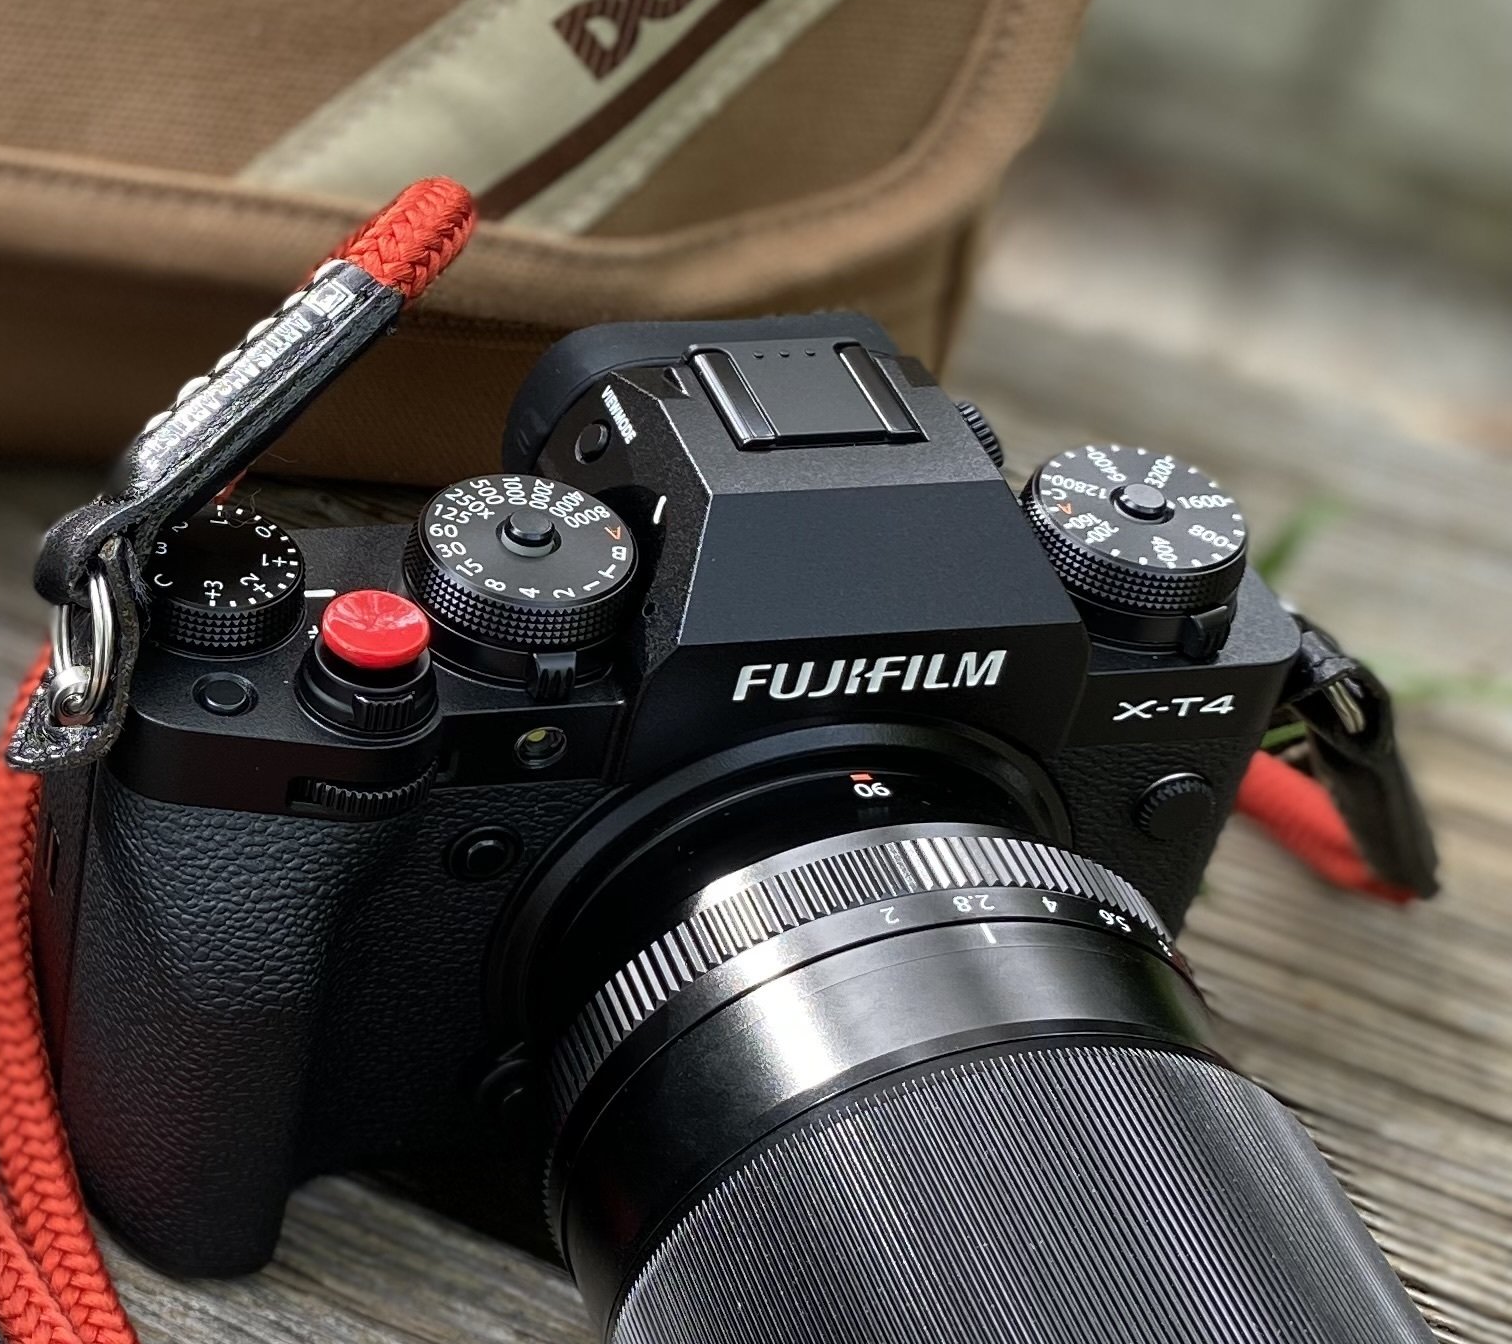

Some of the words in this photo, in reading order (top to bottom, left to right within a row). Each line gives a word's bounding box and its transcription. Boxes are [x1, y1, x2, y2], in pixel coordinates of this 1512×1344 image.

[1087, 451, 1127, 482] 6400
[1144, 458, 1176, 489] 3200
[469, 478, 505, 505] 500
[502, 476, 527, 506] 1000
[529, 478, 555, 510] 2000
[1051, 474, 1107, 499] 12800
[434, 504, 472, 524] 125
[548, 490, 585, 518] 4000
[1177, 494, 1226, 510] 1600
[564, 505, 611, 529] 8000
[429, 524, 458, 537] 60
[604, 525, 621, 540] A
[1088, 520, 1120, 544] 200
[1187, 524, 1229, 548] 800
[436, 541, 467, 558] 30
[611, 545, 627, 561] B
[1150, 536, 1178, 562] 400
[455, 557, 484, 577] 15
[598, 563, 617, 579] T
[484, 578, 506, 591] 8
[518, 586, 540, 599] 4
[552, 586, 577, 599] 2
[732, 649, 1007, 701] FUJIFILM
[1112, 694, 1235, 721] X-T4
[880, 906, 900, 924] 2
[953, 894, 995, 912] 2.8
[1042, 896, 1058, 913] 4
[1099, 909, 1131, 932] 5.6
